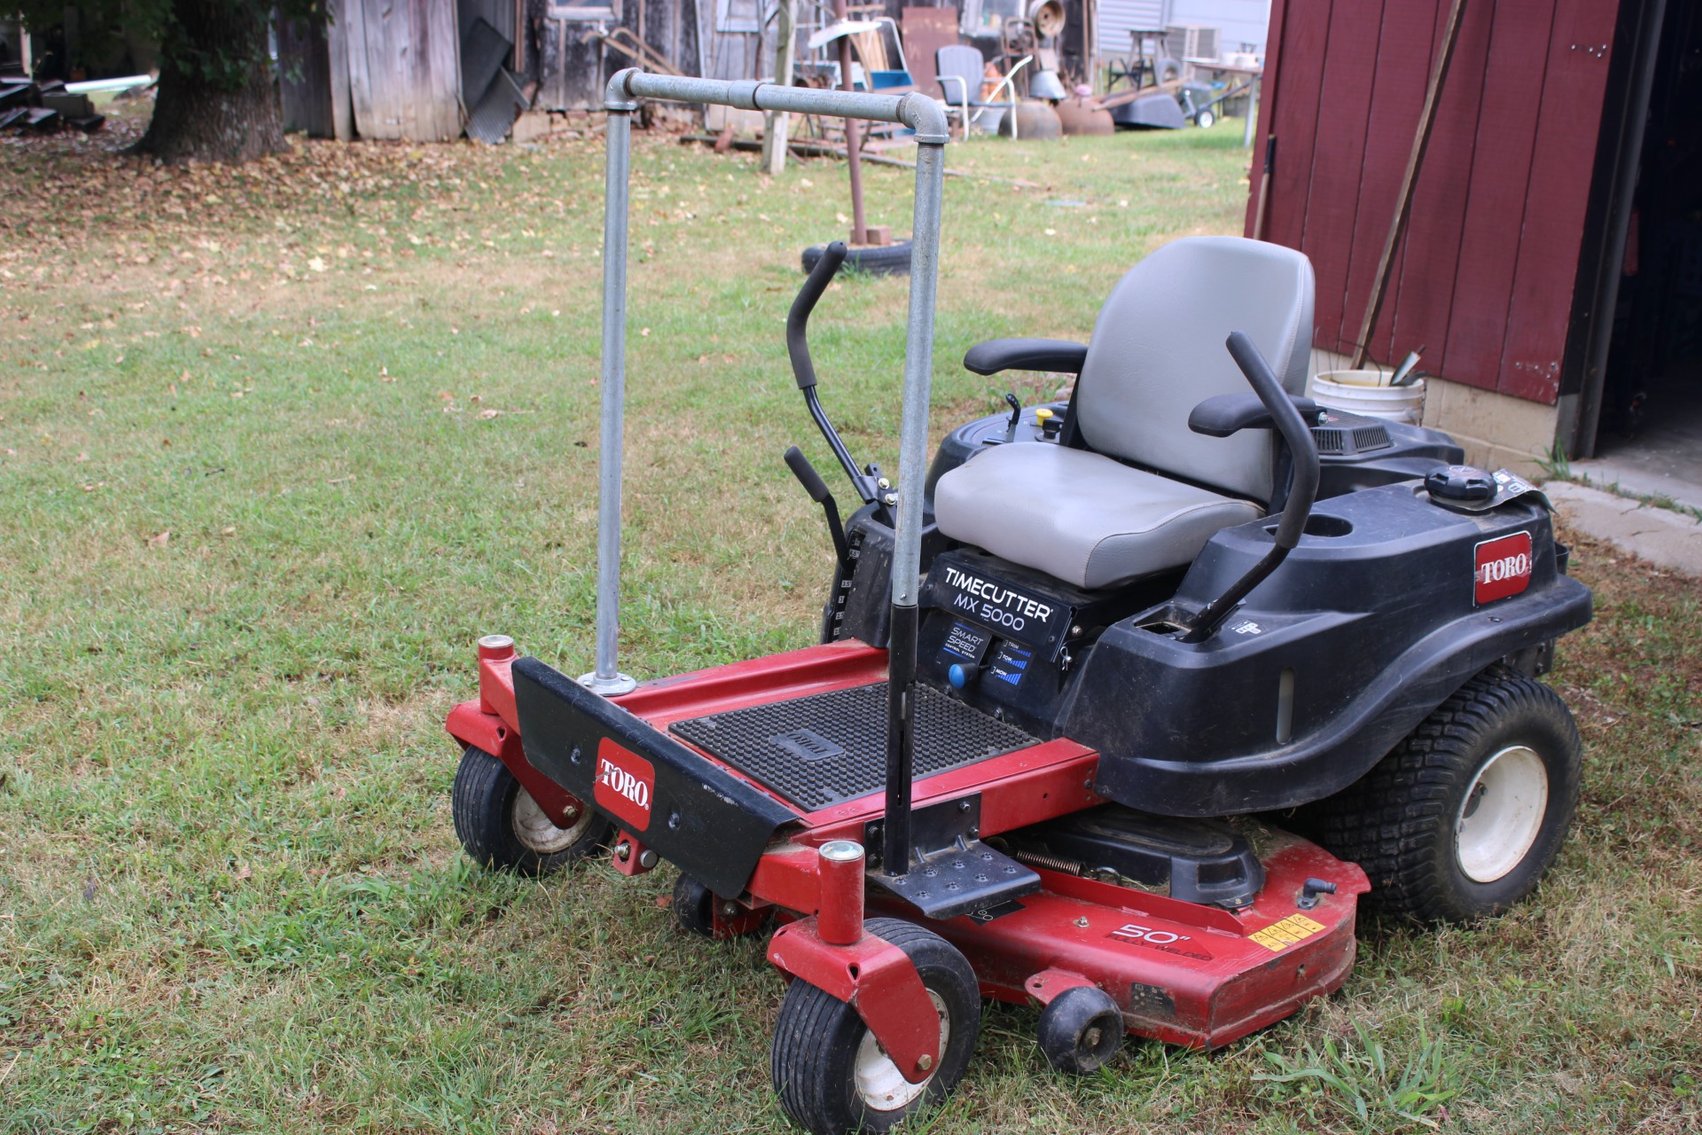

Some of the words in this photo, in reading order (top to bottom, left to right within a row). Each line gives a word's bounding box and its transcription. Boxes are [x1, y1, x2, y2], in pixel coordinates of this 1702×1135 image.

[1481, 552, 1527, 585] TORO
[946, 567, 1050, 623] TIMECUTTER
[954, 593, 979, 613] MX
[980, 603, 1025, 631] 5000
[947, 635, 976, 652] SPEED
[951, 626, 984, 645] SMART
[601, 758, 649, 808] TORO
